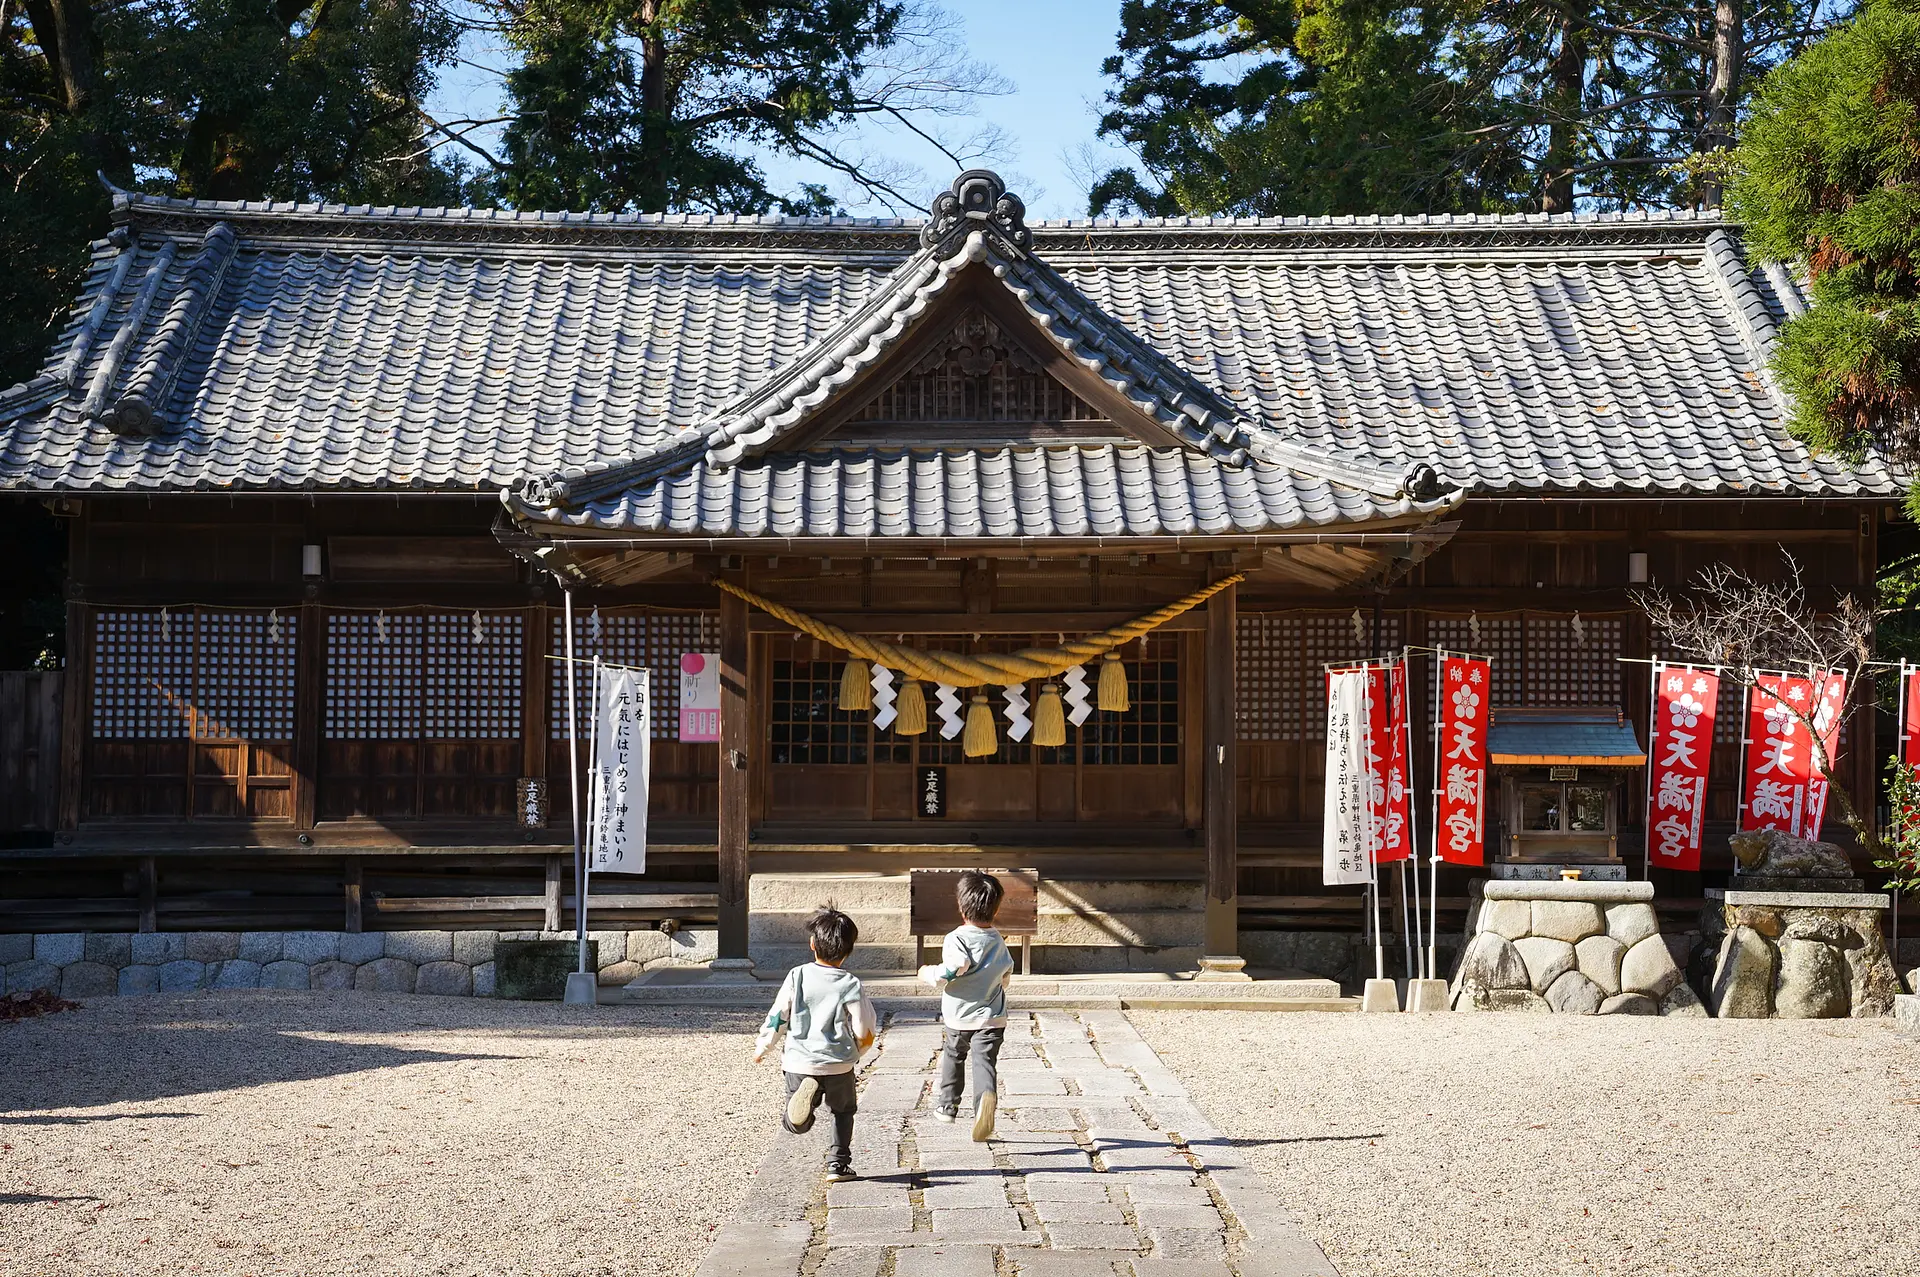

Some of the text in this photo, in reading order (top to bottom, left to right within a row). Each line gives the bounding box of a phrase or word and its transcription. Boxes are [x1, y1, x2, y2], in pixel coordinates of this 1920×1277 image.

[634, 683, 646, 721] 一日を
[685, 673, 701, 703] 祈り
[614, 692, 631, 863] 元気にはじめる 神まいり
[925, 770, 939, 814] 土足厳禁
[525, 781, 539, 825] 土足厳禁
